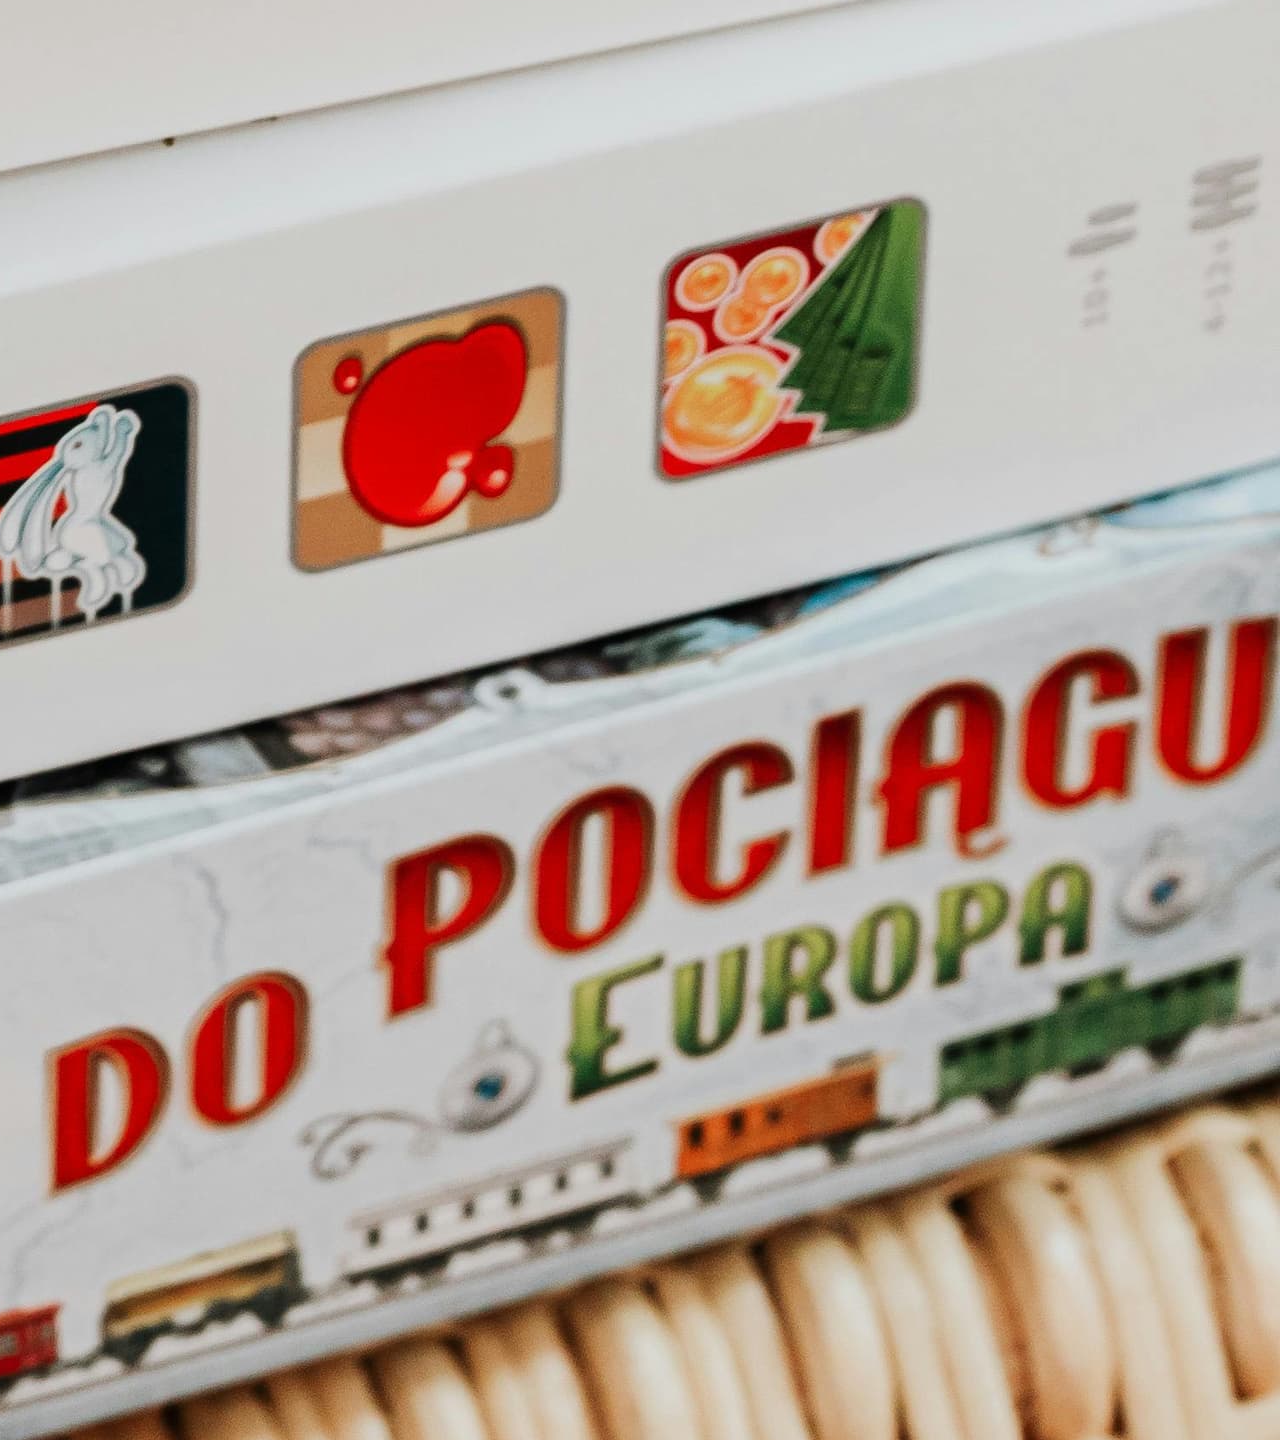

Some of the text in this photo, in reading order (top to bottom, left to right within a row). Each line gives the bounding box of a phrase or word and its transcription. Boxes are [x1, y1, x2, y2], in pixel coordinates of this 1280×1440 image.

[44, 970, 313, 1197] DO
[377, 612, 1280, 1024] POCIĄGU
[565, 860, 1098, 1106] EUROPA
